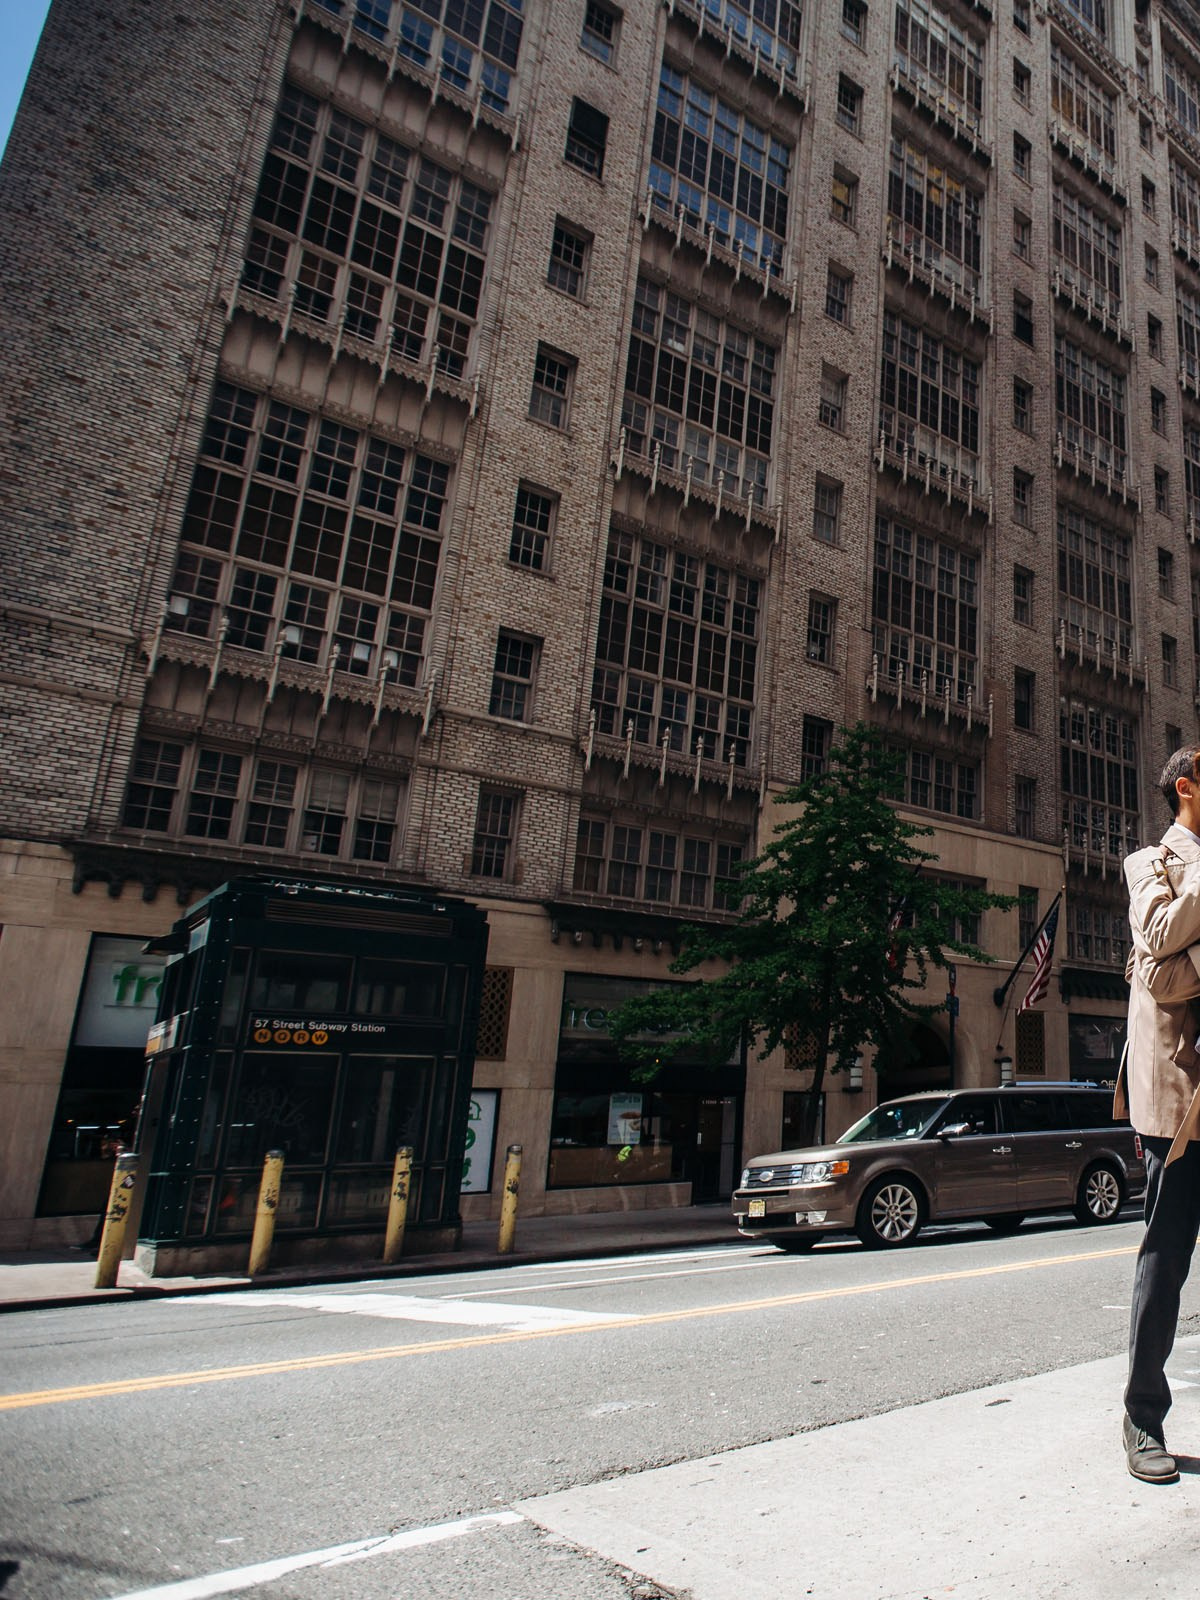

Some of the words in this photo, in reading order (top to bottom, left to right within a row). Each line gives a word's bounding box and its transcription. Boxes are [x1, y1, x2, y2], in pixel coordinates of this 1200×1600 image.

[254, 1019, 268, 1028] 57
[272, 1020, 305, 1029] Street
[308, 1021, 348, 1032] Subway
[351, 1023, 386, 1033] Station
